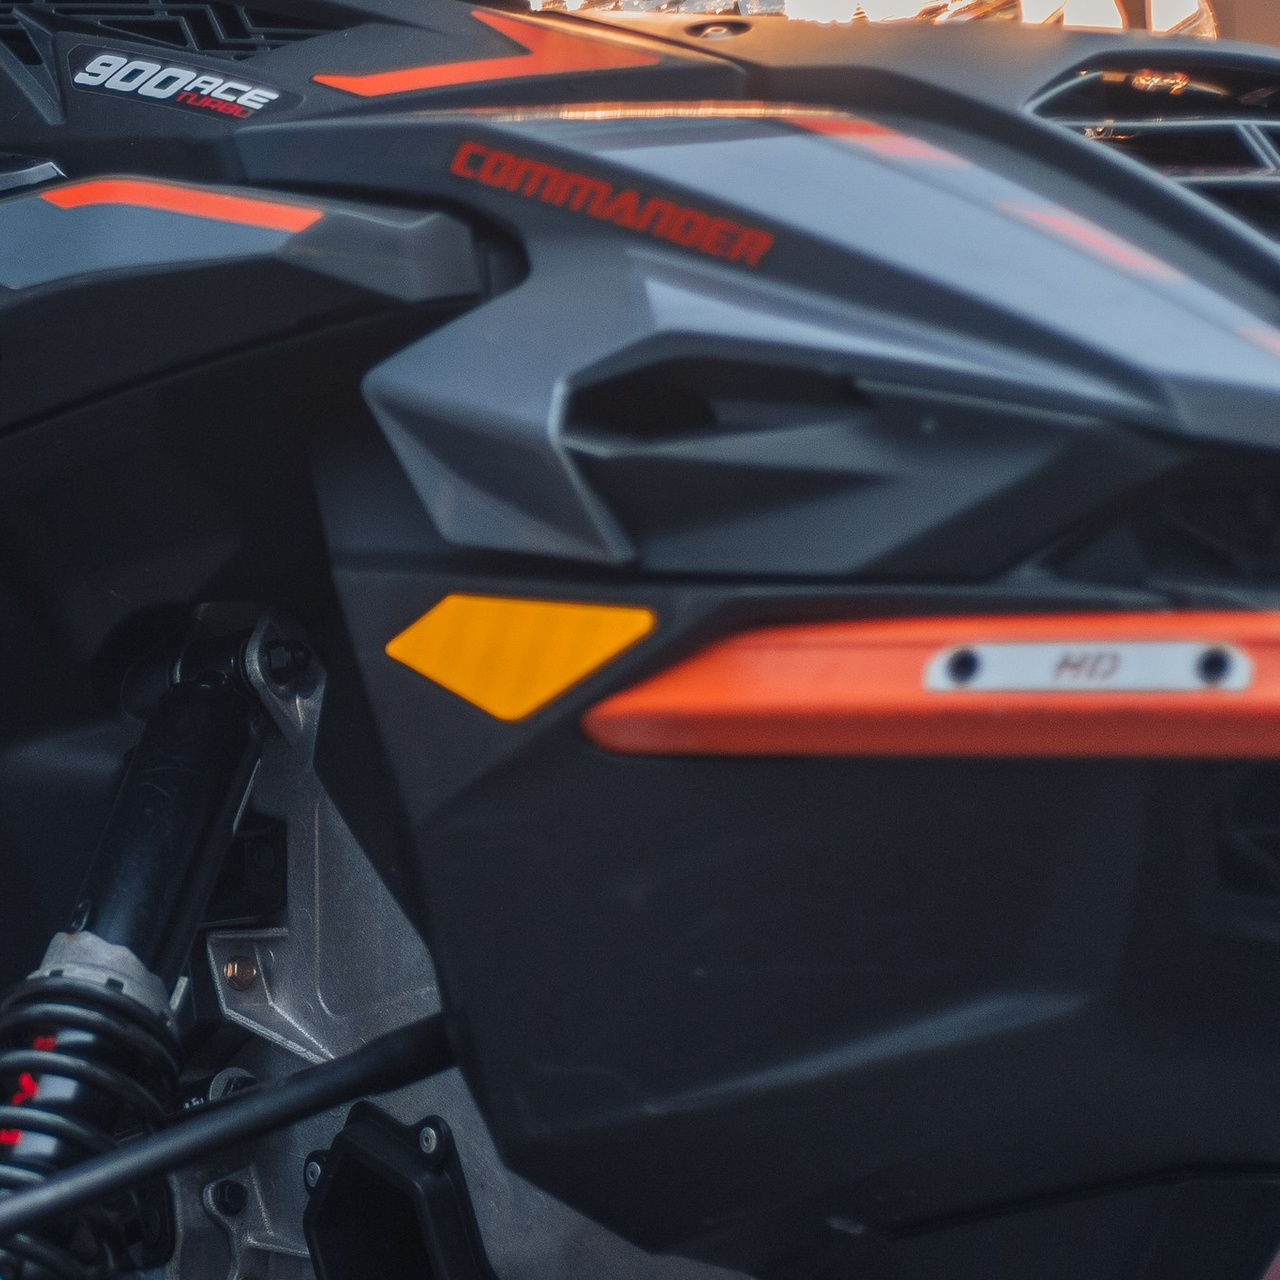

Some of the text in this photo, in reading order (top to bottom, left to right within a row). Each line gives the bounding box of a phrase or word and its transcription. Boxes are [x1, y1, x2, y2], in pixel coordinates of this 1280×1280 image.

[175, 91, 255, 118] TURBO
[449, 141, 773, 266] COMMANDER
[1052, 651, 1122, 682] HD
